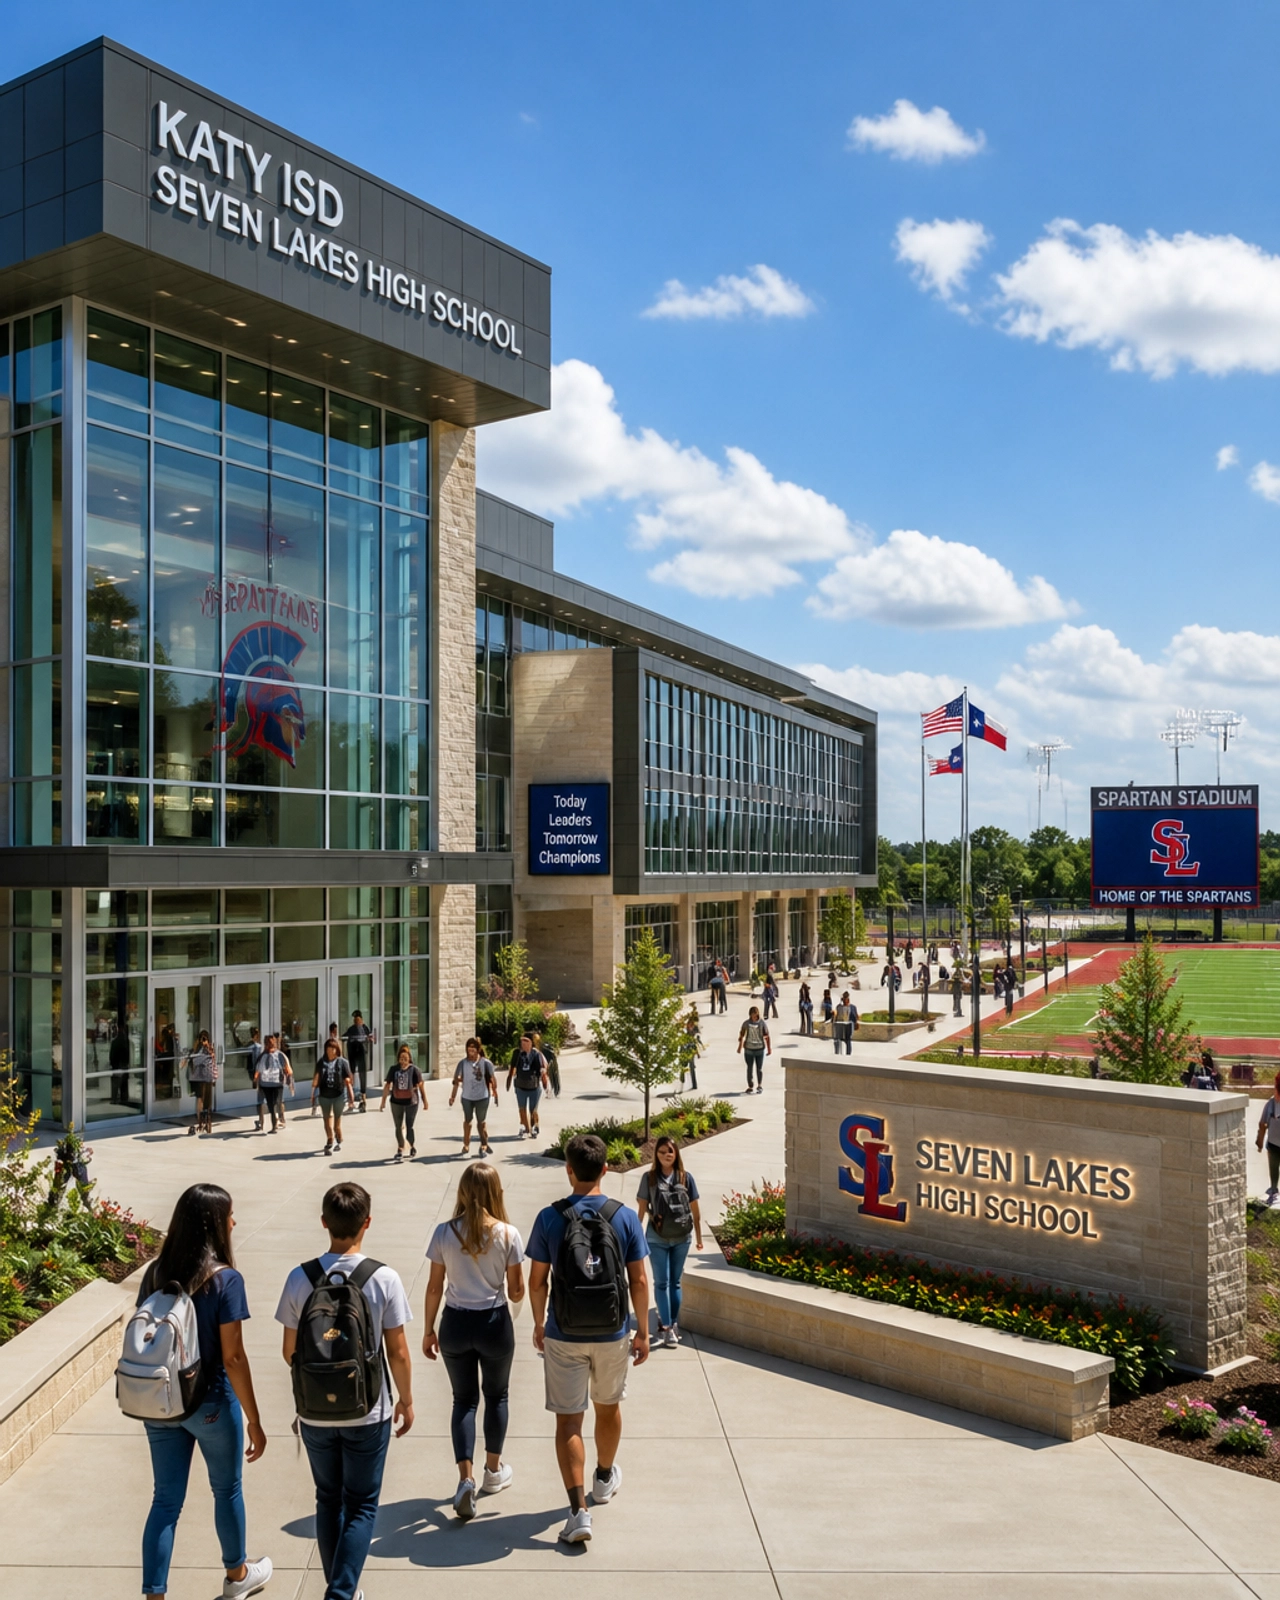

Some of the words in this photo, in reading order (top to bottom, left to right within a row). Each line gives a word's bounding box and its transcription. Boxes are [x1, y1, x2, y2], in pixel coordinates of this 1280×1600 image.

[158, 100, 272, 194] KATY
[283, 162, 344, 228] ISD
[156, 165, 263, 244] SEVEN
[273, 217, 359, 284] LAKES
[367, 259, 426, 314] HIGH
[433, 290, 522, 355] SCHOOL
[553, 793, 587, 811] Today
[1098, 790, 1172, 807] SPARTAN
[1177, 789, 1253, 805] STADIUM
[548, 812, 592, 827] Leaders
[543, 831, 598, 845] Tomorrow
[538, 849, 601, 867] Champions
[1099, 890, 1136, 903] HOME
[1140, 890, 1156, 903] OF
[1159, 890, 1183, 903] THE
[1186, 890, 1252, 903] SPARTANS
[838, 1113, 908, 1223] SL
[915, 1139, 1013, 1183] SEVEN
[1023, 1154, 1131, 1201] LAKES
[915, 1182, 977, 1217] HIGH
[984, 1194, 1098, 1239] SCHOOL
